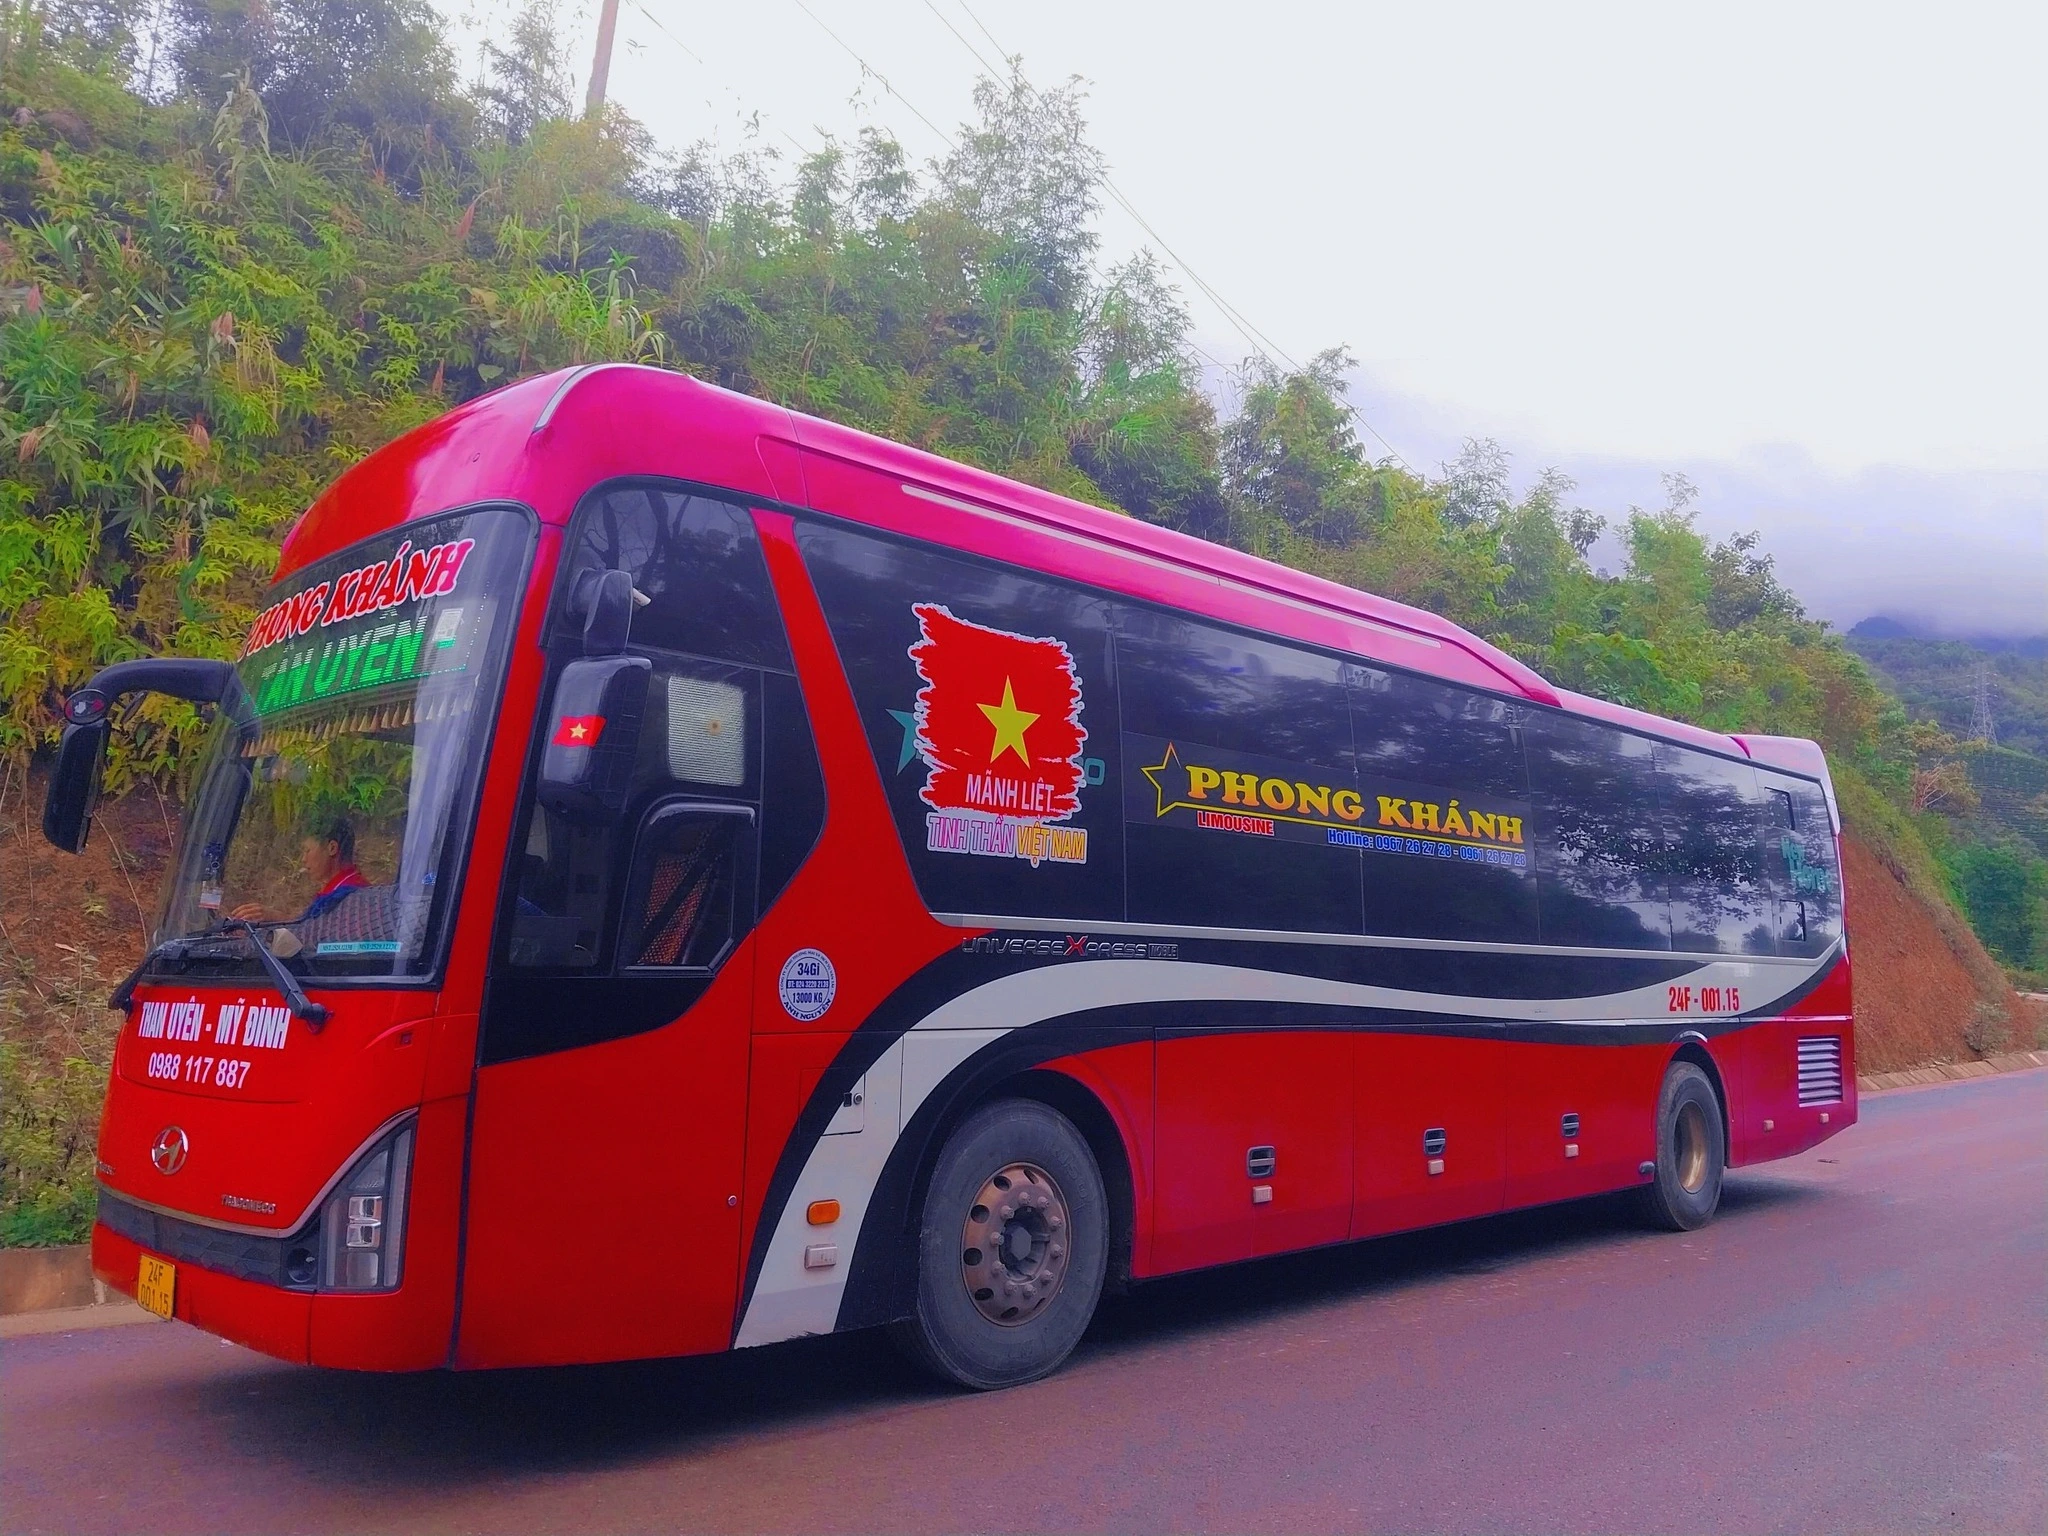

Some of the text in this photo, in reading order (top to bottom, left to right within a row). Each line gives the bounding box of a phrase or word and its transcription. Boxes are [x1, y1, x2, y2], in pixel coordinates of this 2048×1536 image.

[237, 538, 475, 662] PHONG KHÁNH
[965, 769, 1018, 808] MÃNH
[1185, 765, 1524, 844] PHONG KHÁNH
[929, 816, 968, 850] TINH
[1017, 821, 1050, 865] VIỆT
[1051, 828, 1085, 860] NAM
[1196, 811, 1275, 836] LIMOUSINE
[1327, 828, 1374, 849] Hotline:
[1375, 835, 1403, 852] 0967
[1406, 839, 1420, 854] 26
[1422, 841, 1436, 856] 27
[1438, 843, 1451, 857] 28
[1459, 846, 1485, 862] 0961
[1486, 849, 1499, 864] 26
[1500, 851, 1512, 865] 27
[1514, 852, 1526, 867] 28
[797, 962, 820, 976] 34Gi
[784, 1001, 799, 1018] ANH
[793, 992, 823, 1003] 13000 KG
[1669, 986, 1691, 1012] 24F
[1701, 987, 1740, 1012] 001.15
[138, 1002, 168, 1039] THAN
[166, 995, 205, 1042] UYÊN
[215, 997, 245, 1045] MỸ
[148, 1052, 251, 1089] 0988 117 887
[148, 1261, 164, 1286] 24F
[141, 1284, 169, 1316] 001.15
